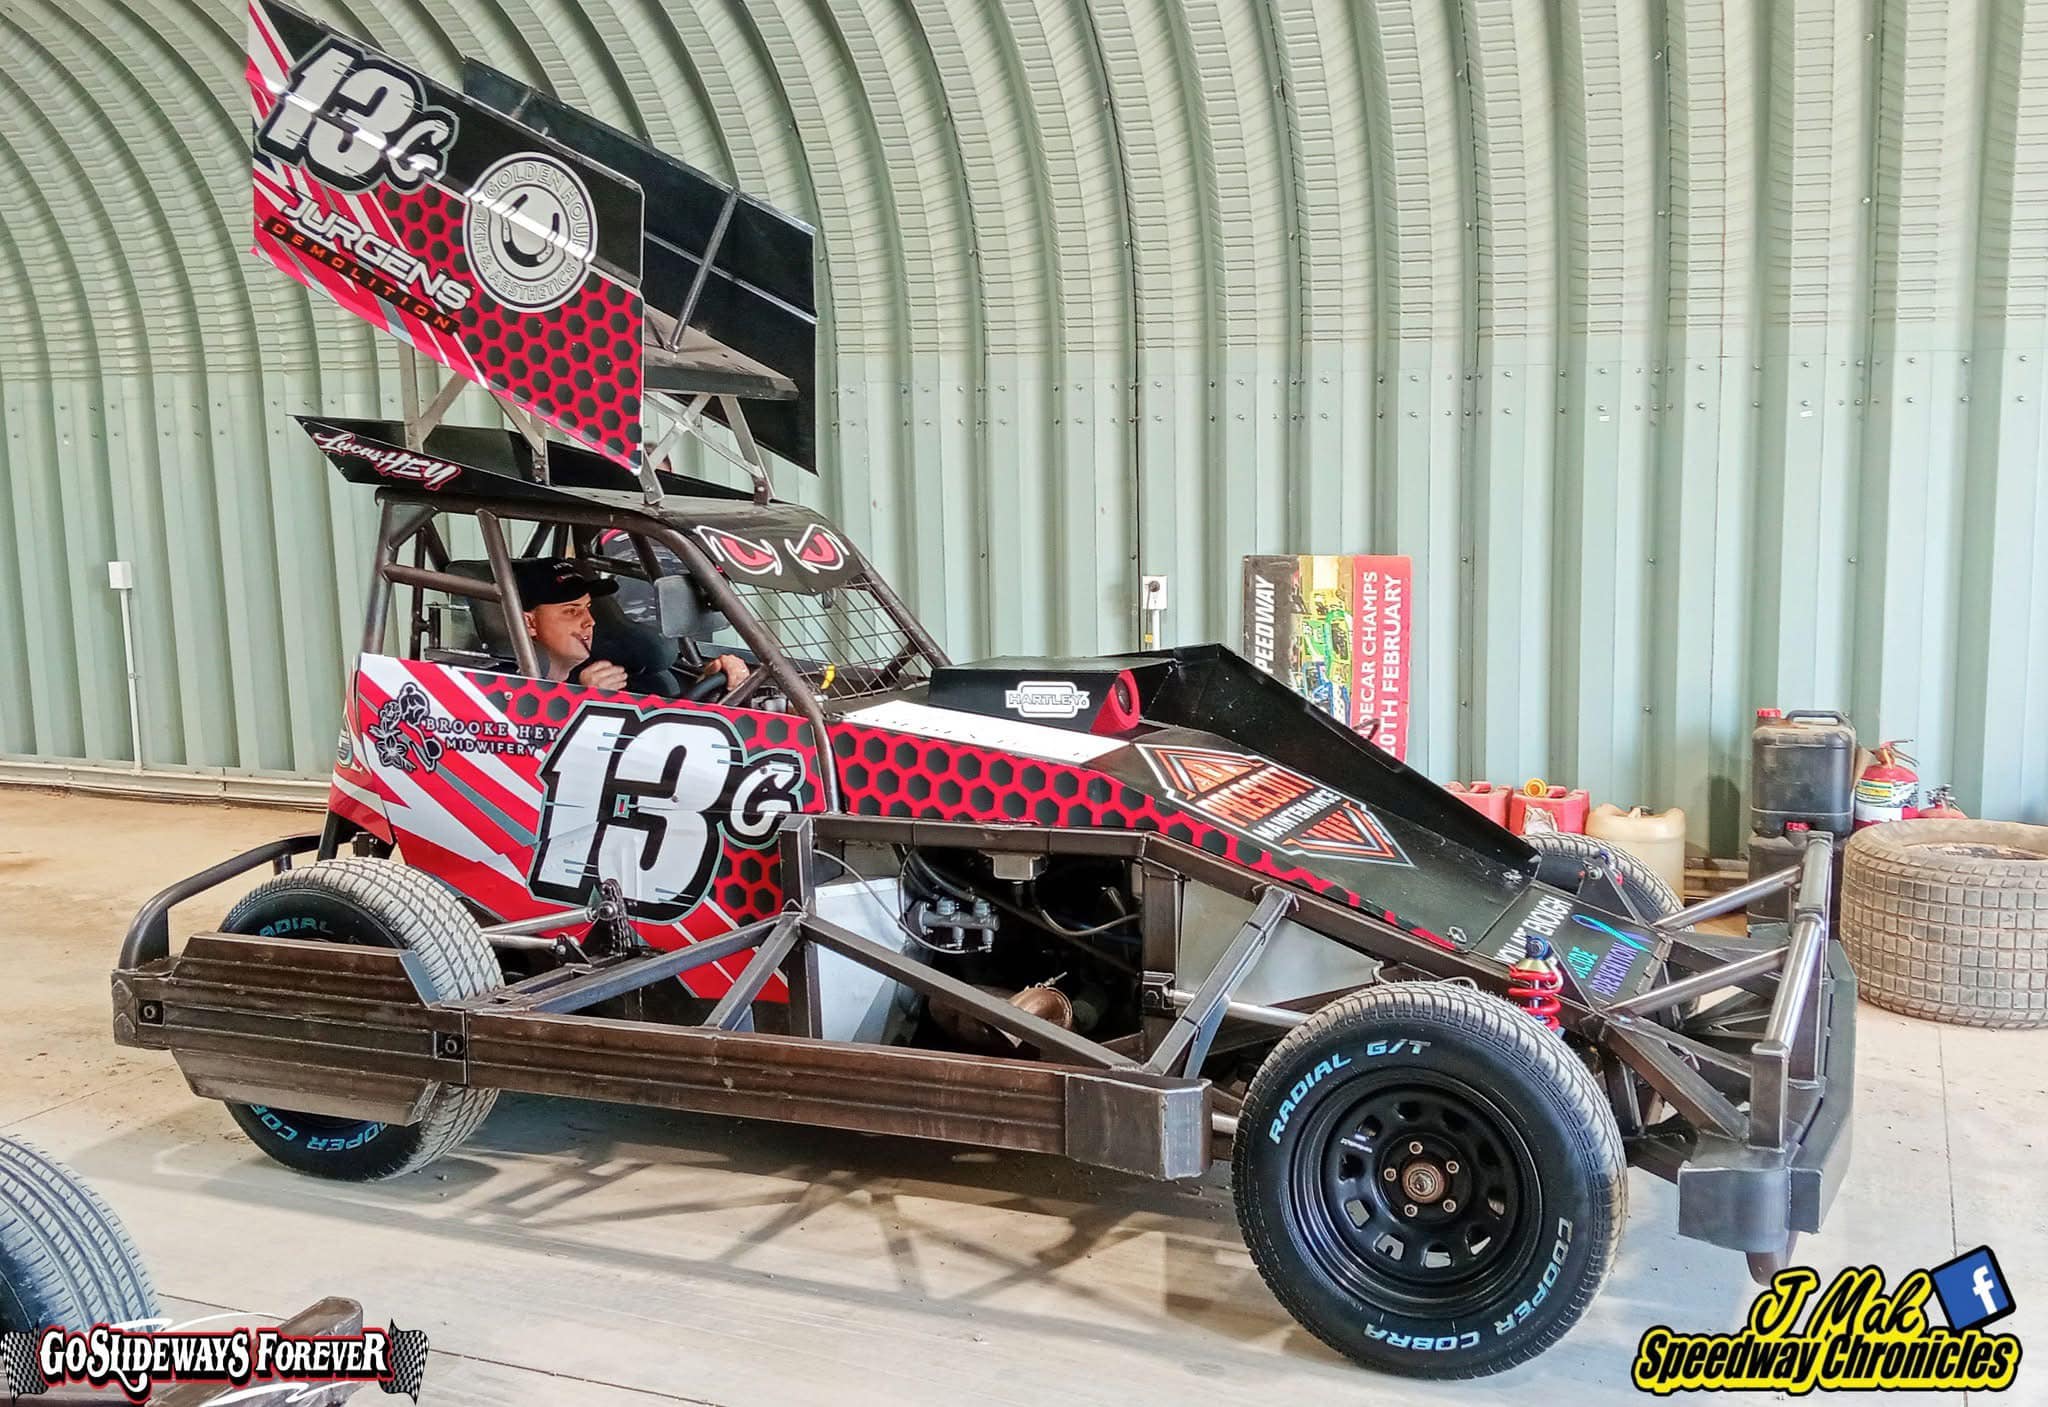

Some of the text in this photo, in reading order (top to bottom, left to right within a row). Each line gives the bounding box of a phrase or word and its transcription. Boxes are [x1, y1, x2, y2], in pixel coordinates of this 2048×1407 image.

[485, 163, 566, 199] GOLDEN
[272, 223, 450, 329] DEMOLITION
[284, 194, 471, 310] JURGENS
[489, 262, 577, 301] AESTHETICS
[1254, 575, 1276, 675] PEEDWAY
[1381, 574, 1402, 692] FEBRUARY
[1358, 571, 1378, 737] IDECAR CHAMPS
[425, 717, 559, 741] BROOKE HEY
[446, 738, 537, 756] MIDWIFERY
[1195, 767, 1314, 827] PRESCOTT
[1253, 789, 1341, 841] MAINTENANCE
[259, 917, 335, 937] ADIAL
[1522, 894, 1574, 936] ENOUGH
[1591, 942, 1639, 998] PREVENTION
[1269, 1039, 1431, 1145] RADIAL G/T
[306, 1121, 388, 1152] OPER
[1364, 1216, 1574, 1352] COOPER COBRA
